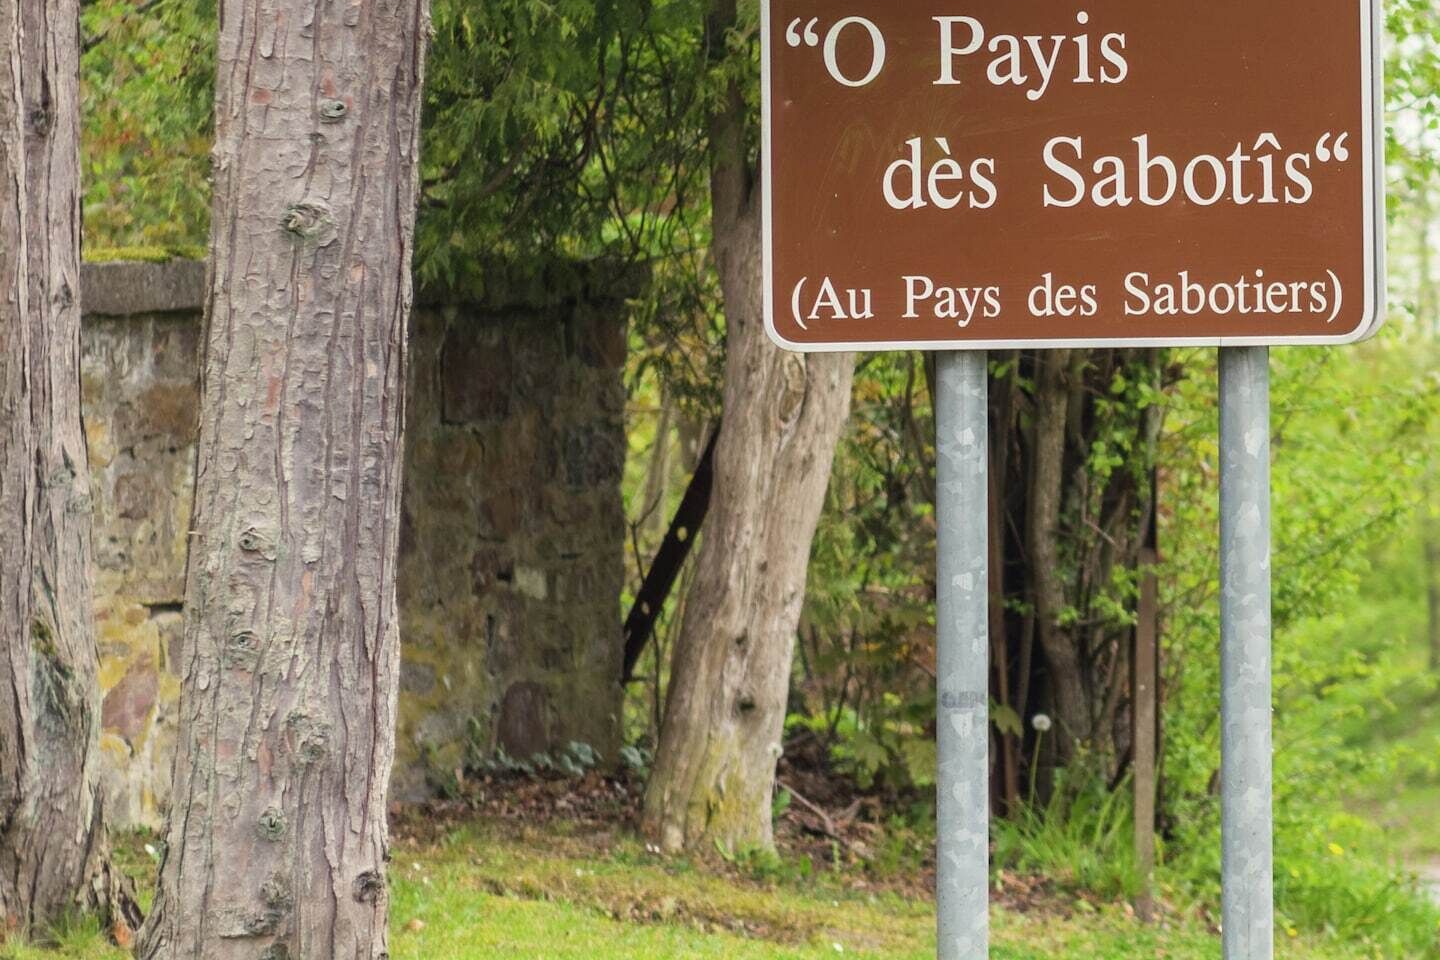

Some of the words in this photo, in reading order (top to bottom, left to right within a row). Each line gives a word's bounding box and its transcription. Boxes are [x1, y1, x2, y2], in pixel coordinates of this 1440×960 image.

[785, 16, 886, 87] “O
[932, 11, 1128, 101] Payis
[882, 136, 998, 210] dès
[791, 276, 875, 330] (Au
[902, 275, 1001, 328] Pays
[1028, 271, 1098, 317] des
[1124, 269, 1343, 323] Sabotiers)
